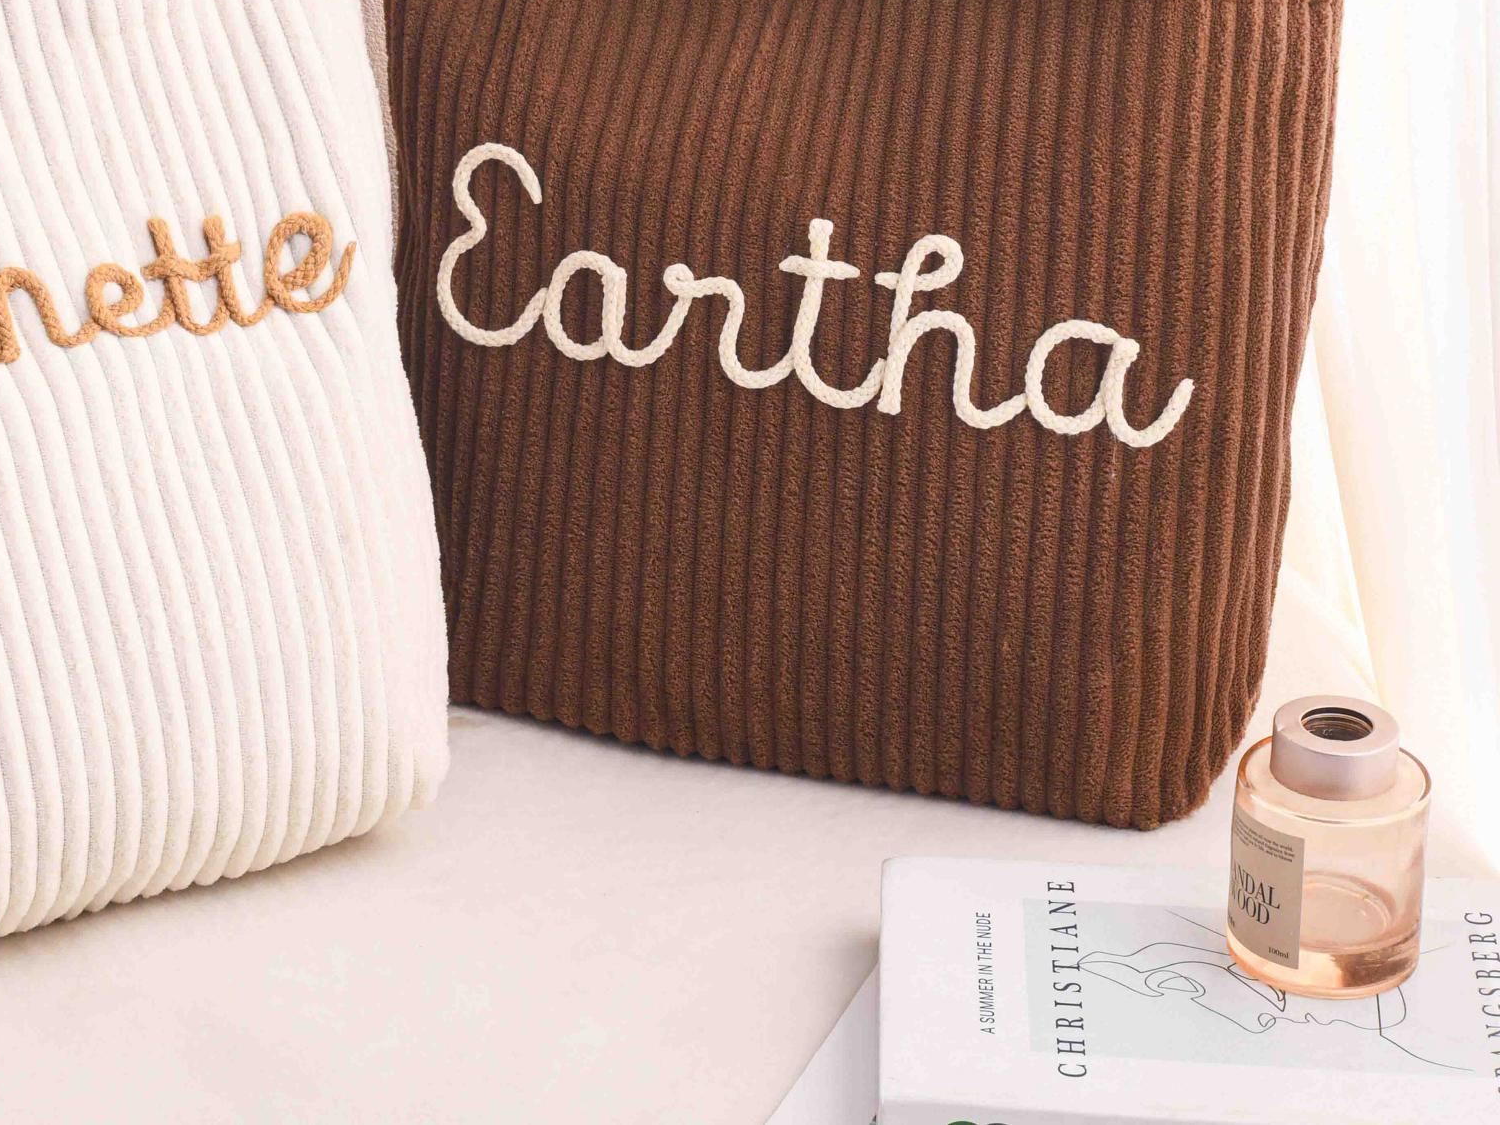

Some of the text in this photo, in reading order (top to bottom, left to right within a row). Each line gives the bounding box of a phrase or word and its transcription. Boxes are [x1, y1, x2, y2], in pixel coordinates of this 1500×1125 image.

[436, 142, 1194, 447] Eartha
[975, 912, 996, 1035] A SUMMER IN THE NUDE
[1047, 881, 1087, 1078] CHRISTIANE
[1268, 946, 1289, 959] 100ml
